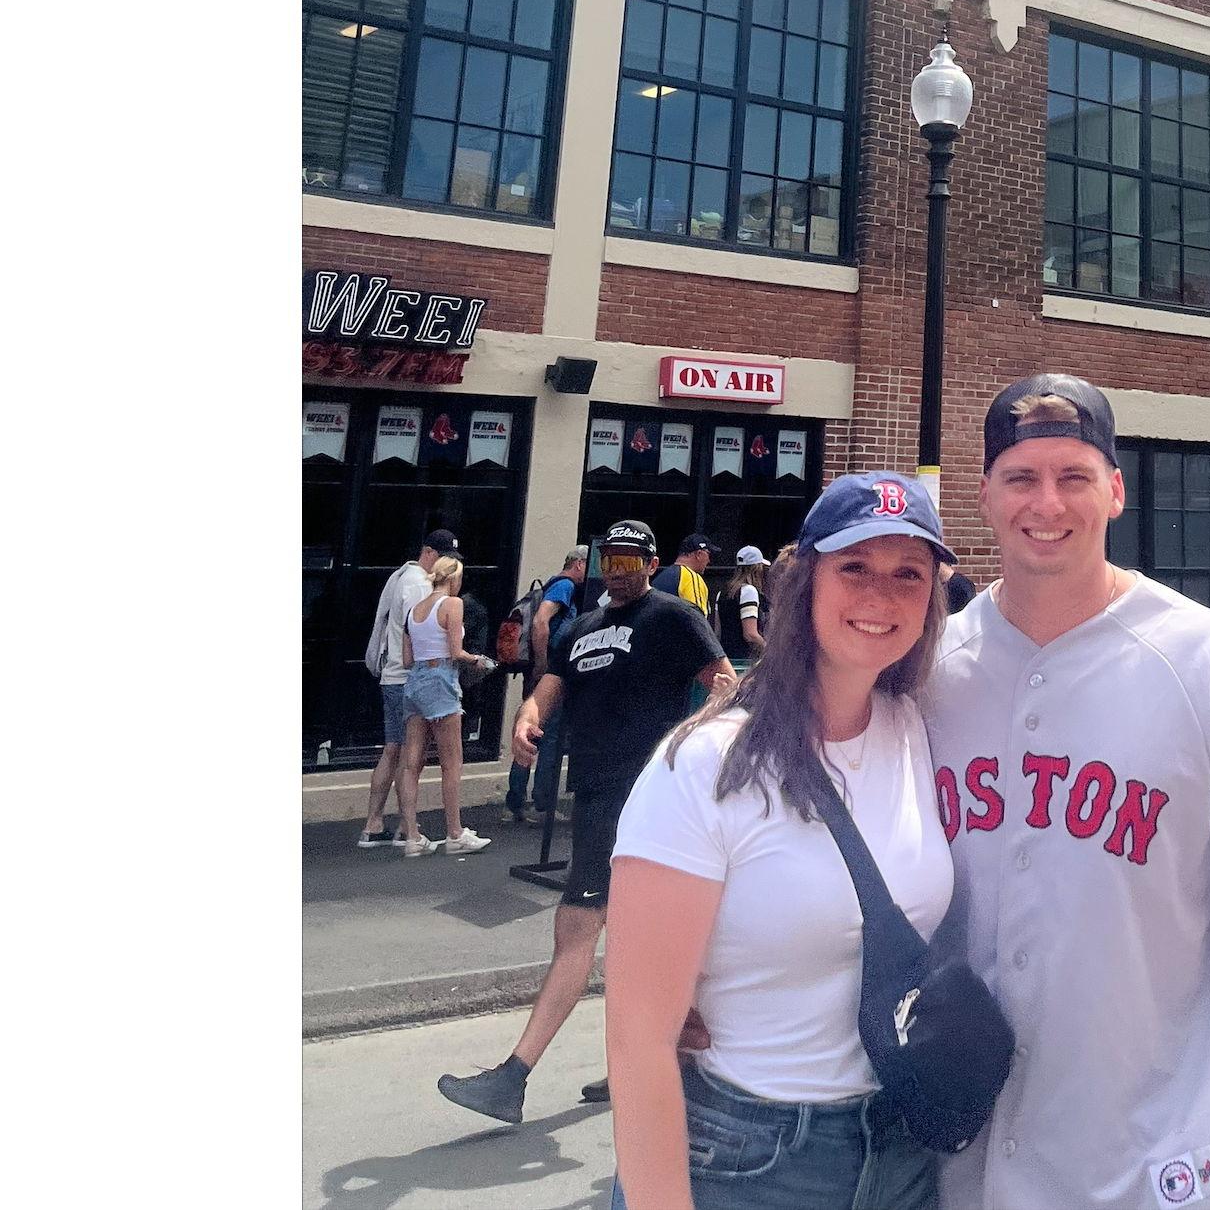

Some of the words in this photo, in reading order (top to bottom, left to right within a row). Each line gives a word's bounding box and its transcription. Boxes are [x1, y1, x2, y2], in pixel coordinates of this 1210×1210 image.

[308, 271, 486, 346] WEEI
[679, 367, 719, 389] ON
[725, 371, 775, 393] AIR
[872, 480, 908, 517] B
[607, 526, 647, 541] Titleist
[935, 751, 1169, 865] OSTON
